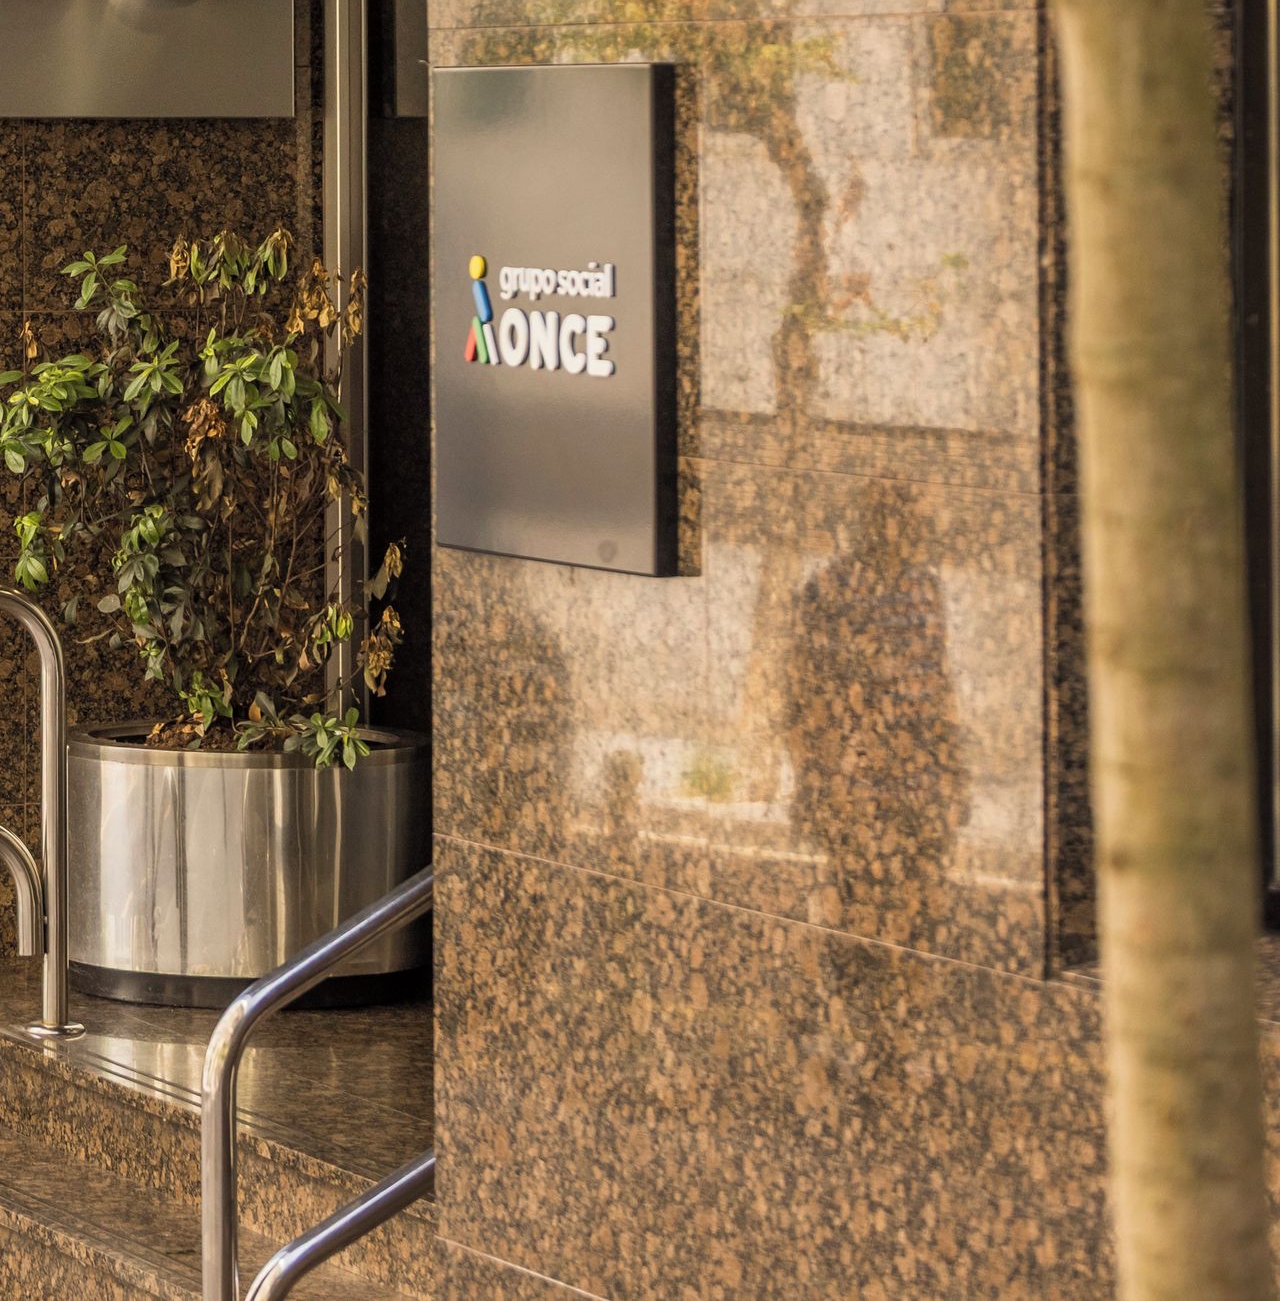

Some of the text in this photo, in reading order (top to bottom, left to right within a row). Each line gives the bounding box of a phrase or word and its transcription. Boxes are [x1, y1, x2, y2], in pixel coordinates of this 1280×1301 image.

[498, 261, 615, 301] grupo social
[498, 307, 615, 377] ONCE
